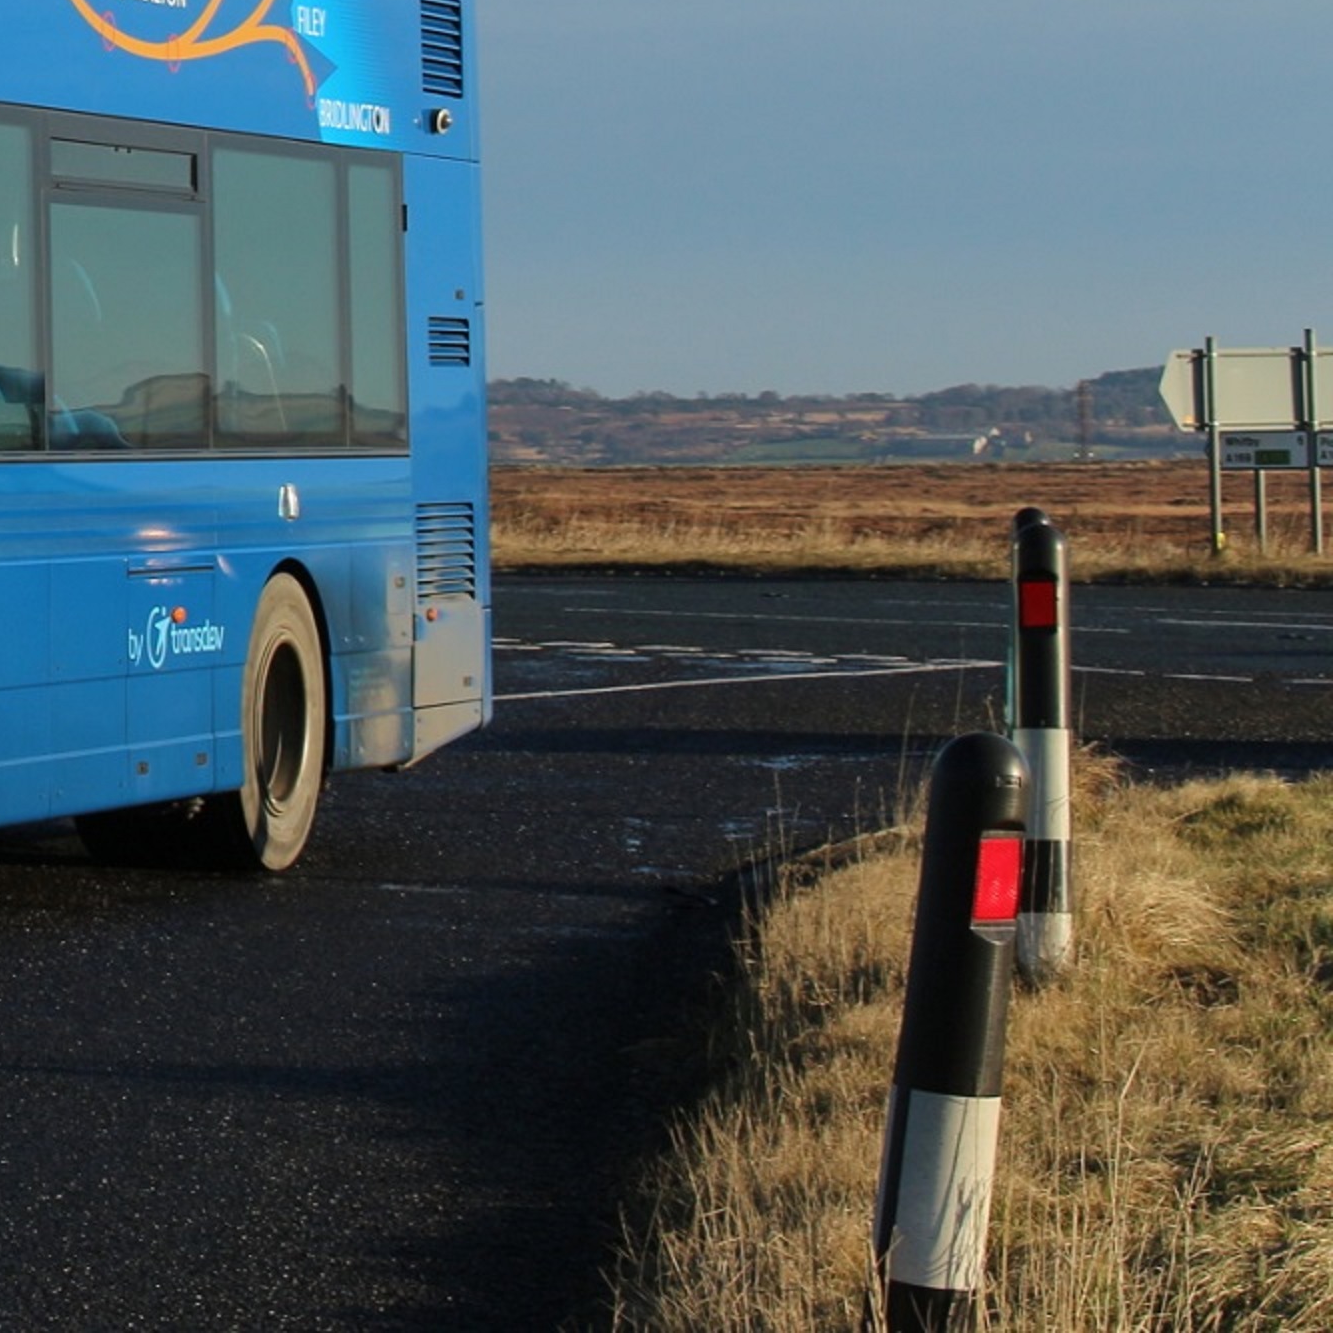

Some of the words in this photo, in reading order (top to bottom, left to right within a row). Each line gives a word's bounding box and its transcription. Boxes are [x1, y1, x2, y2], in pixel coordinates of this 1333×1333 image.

[297, 5, 326, 37] FILEY
[319, 97, 391, 135] BRIDLINGTON
[128, 628, 143, 668] by
[170, 618, 225, 654] transdev
